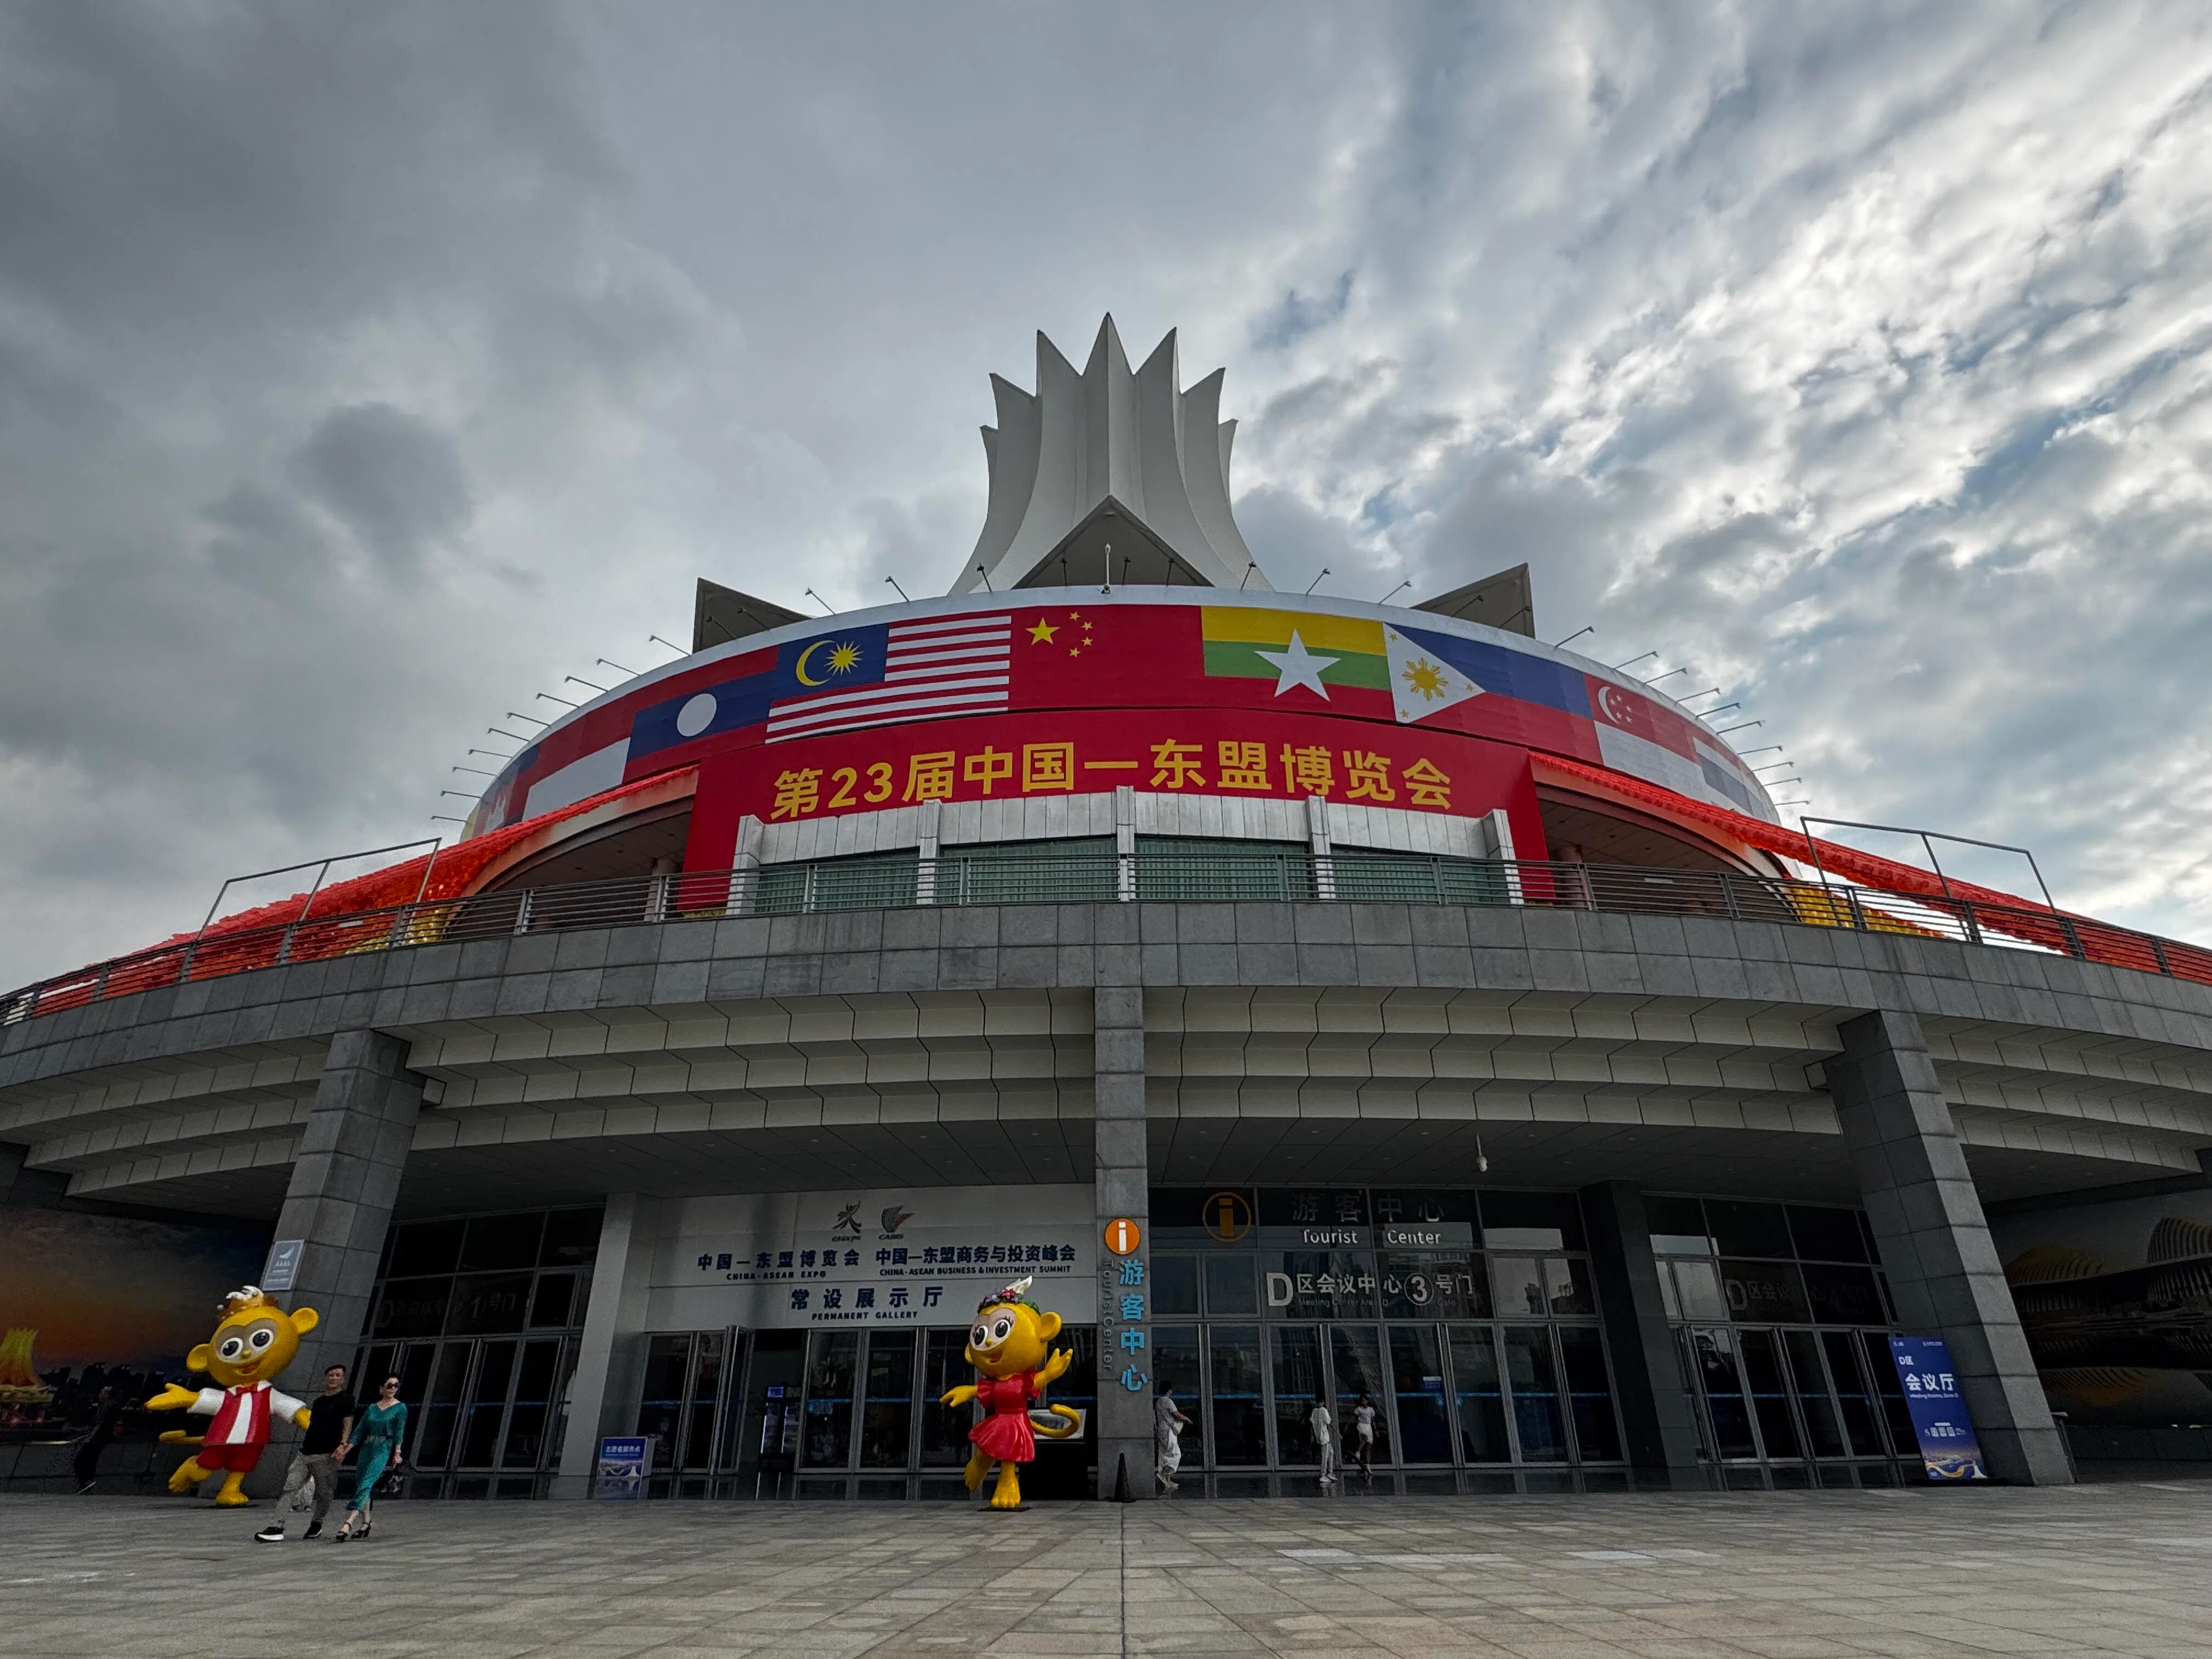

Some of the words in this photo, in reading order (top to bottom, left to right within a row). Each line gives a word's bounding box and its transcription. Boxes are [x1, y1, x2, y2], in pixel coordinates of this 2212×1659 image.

[1301, 1229, 1358, 1244] Tourist
[1387, 1229, 1441, 1244] Center
[801, 1271, 826, 1279] EXPO
[937, 1266, 977, 1274] BUSINESS
[985, 1266, 1036, 1274] INVESTMENT
[1039, 1265, 1071, 1273] SUMMIT
[791, 1286, 943, 1310] 常设展示厅
[811, 1312, 869, 1321] PERMANENT
[875, 1311, 918, 1319] GALLERY
[1119, 1259, 1148, 1391] 游客中心
[1898, 1356, 1914, 1365] D区
[1905, 1373, 1954, 1391] 会议厅
